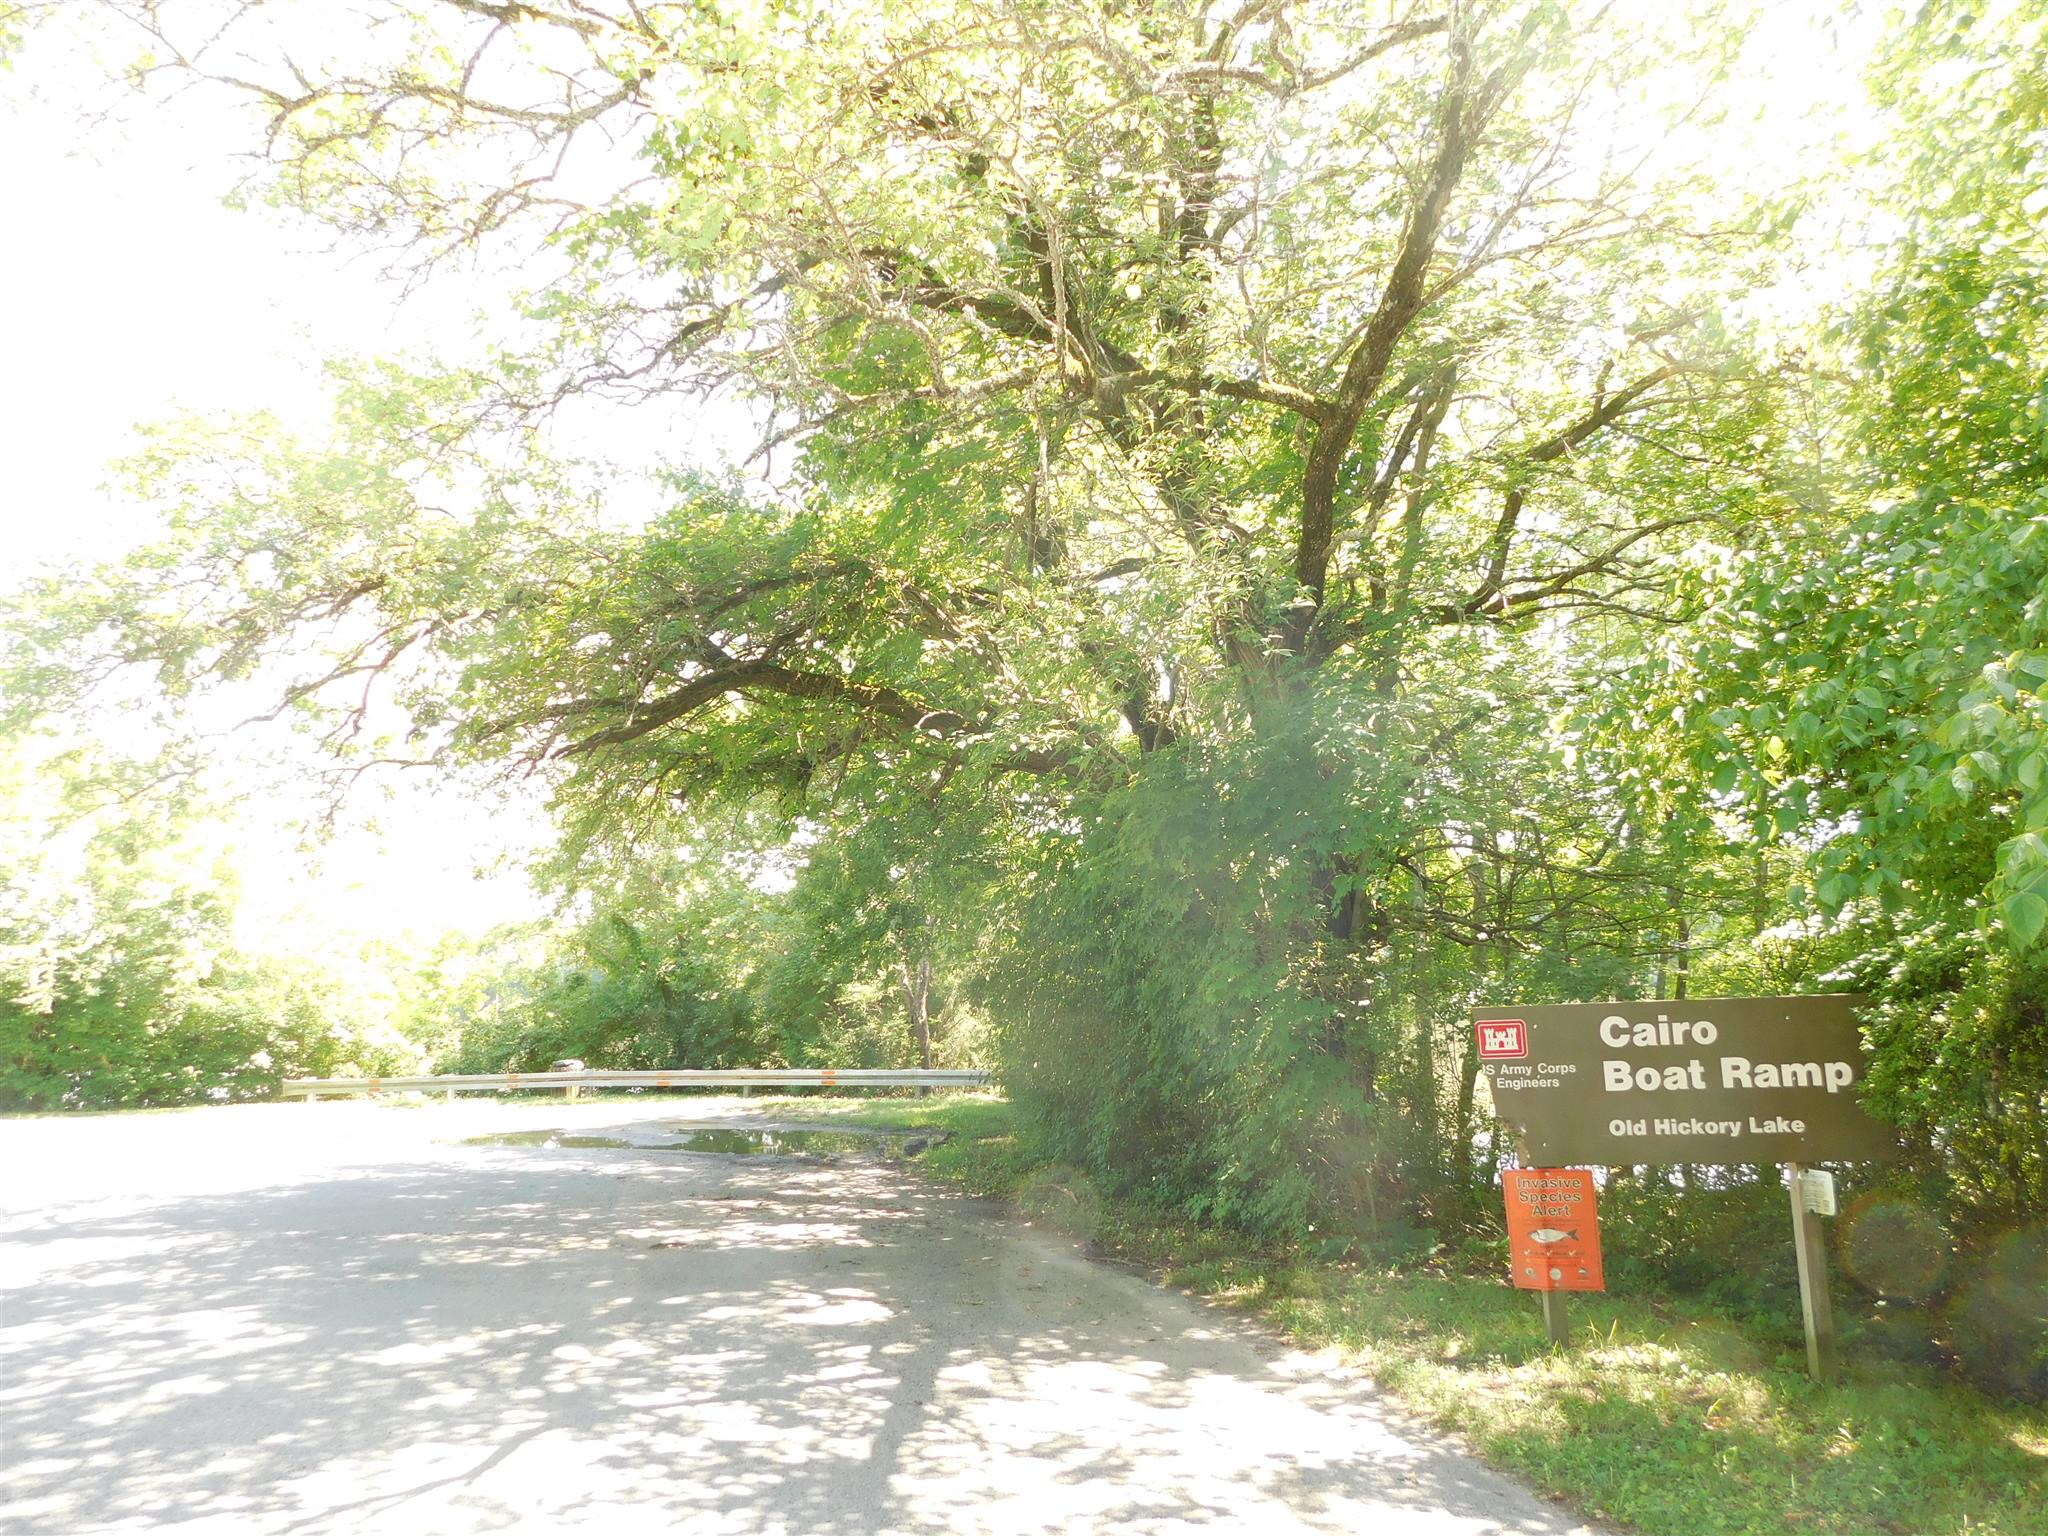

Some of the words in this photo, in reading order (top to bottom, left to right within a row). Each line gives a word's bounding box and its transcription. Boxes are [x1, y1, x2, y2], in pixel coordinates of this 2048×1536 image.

[1600, 1015, 1718, 1048] Cairo
[1500, 1064, 1532, 1076] Army
[1537, 1063, 1576, 1075] Corps
[1602, 1059, 1706, 1092] Boat
[1720, 1057, 1853, 1093] Ramp
[1496, 1077, 1560, 1090] Engineers
[1608, 1119, 1647, 1136] Old
[1654, 1118, 1742, 1137] Hickory
[1748, 1116, 1806, 1134] Lake
[1516, 1176, 1582, 1189] Invasive
[1519, 1190, 1582, 1205] Species
[1532, 1205, 1572, 1217] Alert
